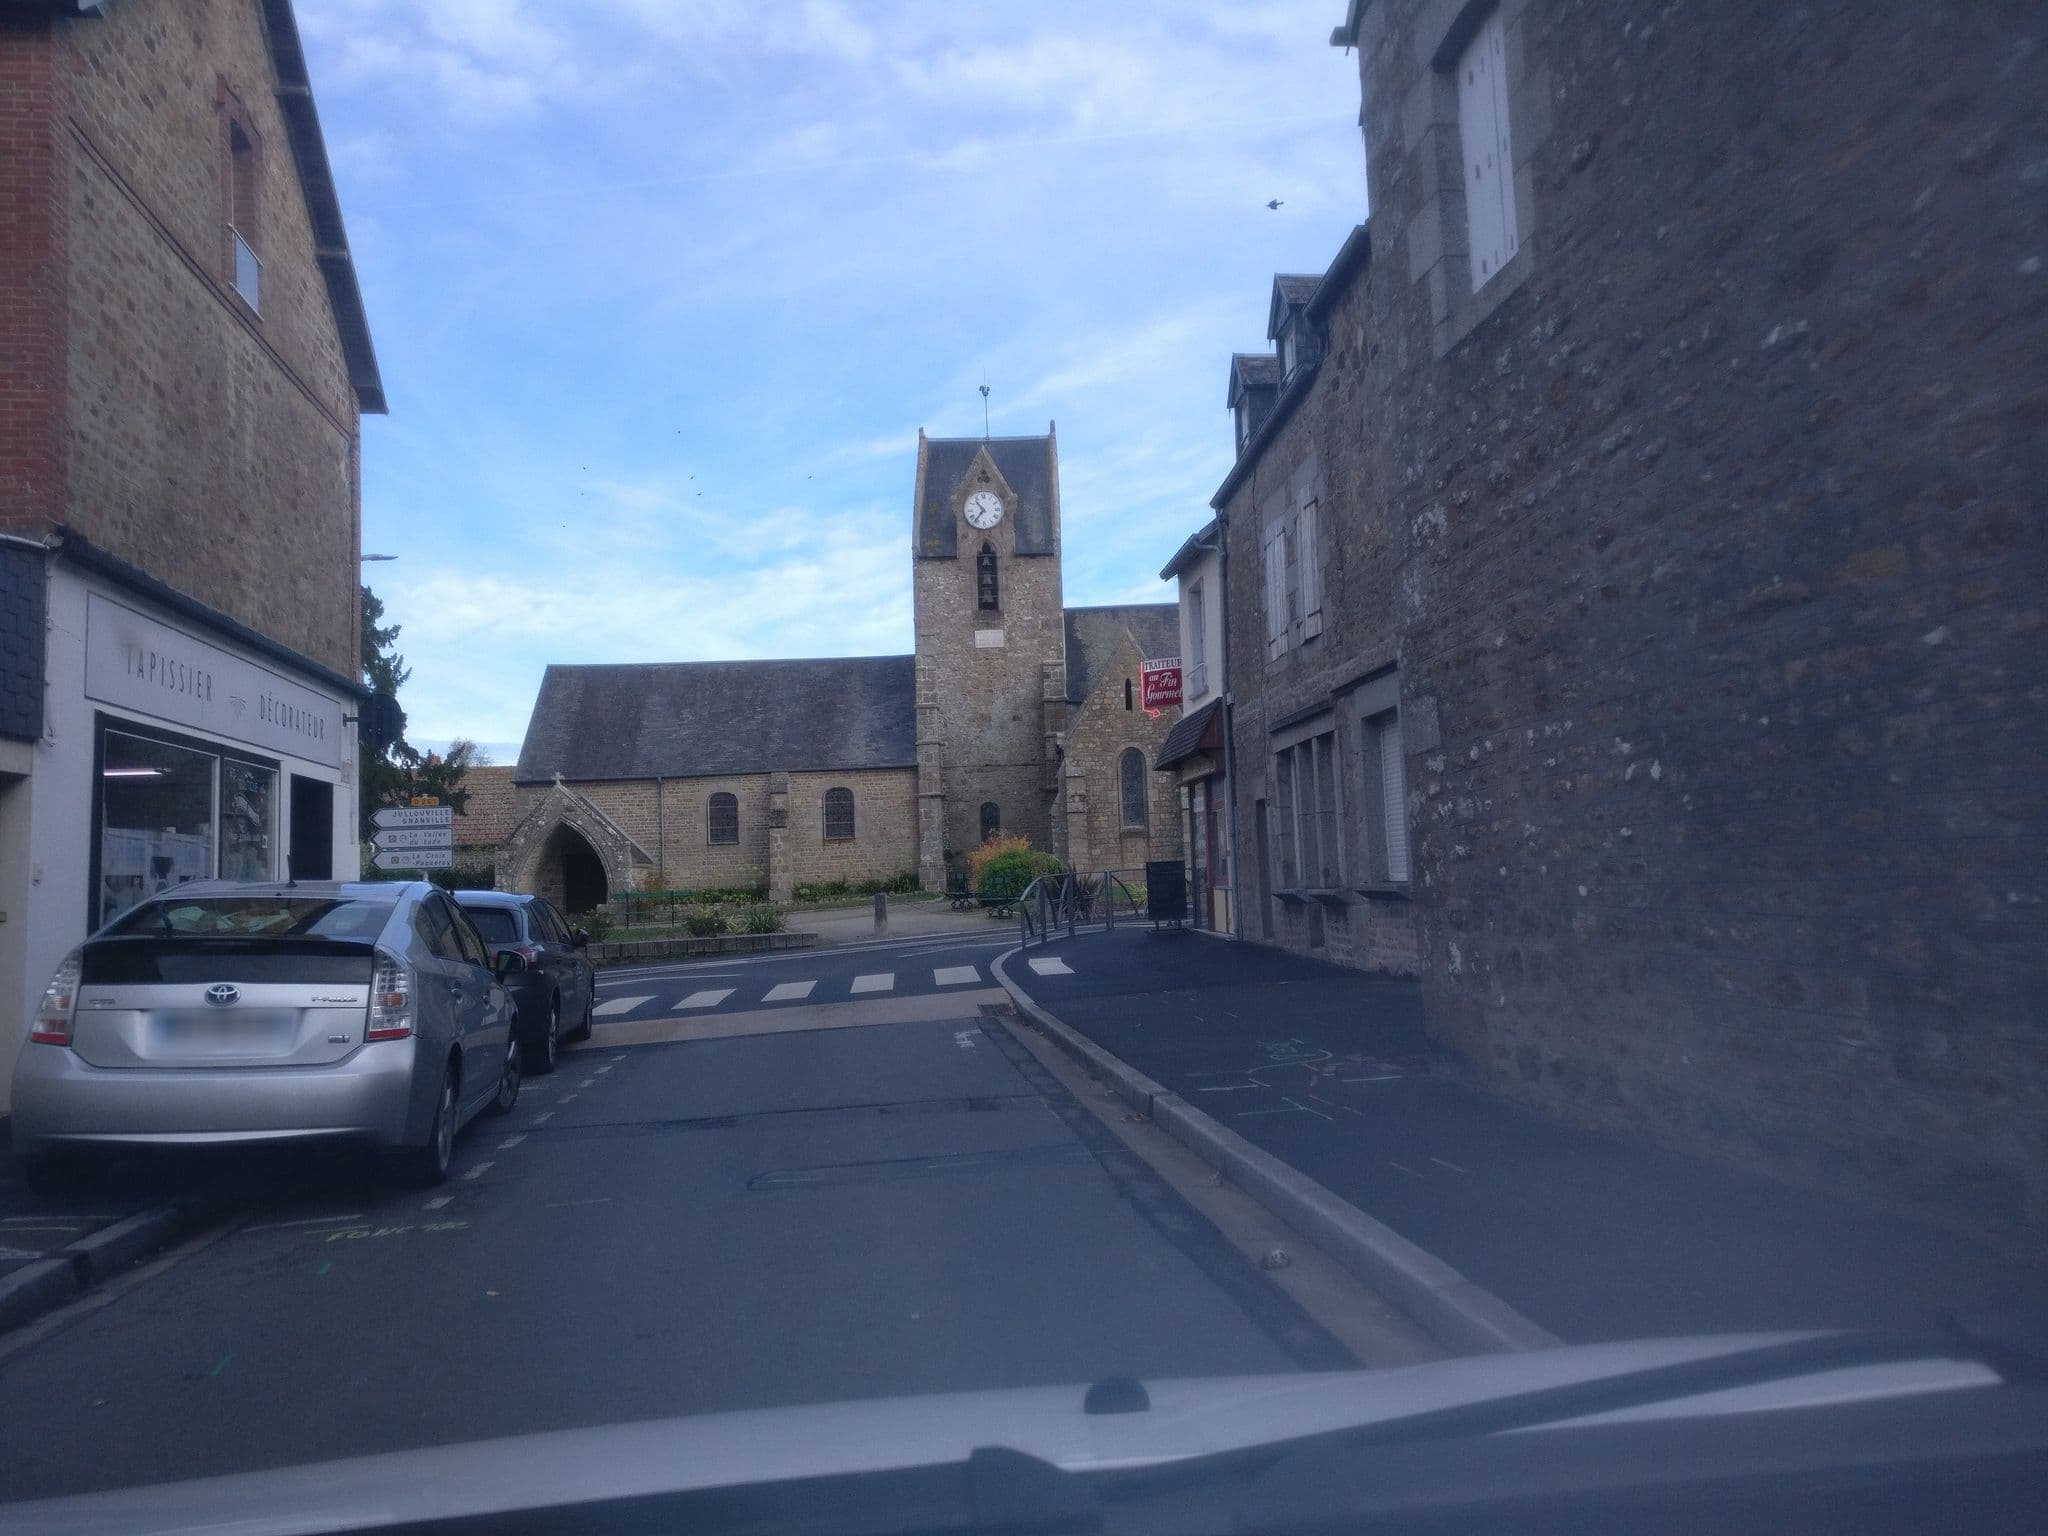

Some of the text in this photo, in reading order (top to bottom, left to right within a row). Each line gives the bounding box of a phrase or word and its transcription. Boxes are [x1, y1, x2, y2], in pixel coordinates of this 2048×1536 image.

[1160, 672, 1177, 688] Fin
[260, 691, 325, 742] DÉCORATEUR
[393, 809, 450, 818] JULLOUVILLE
[402, 816, 450, 825] GRANVILLE
